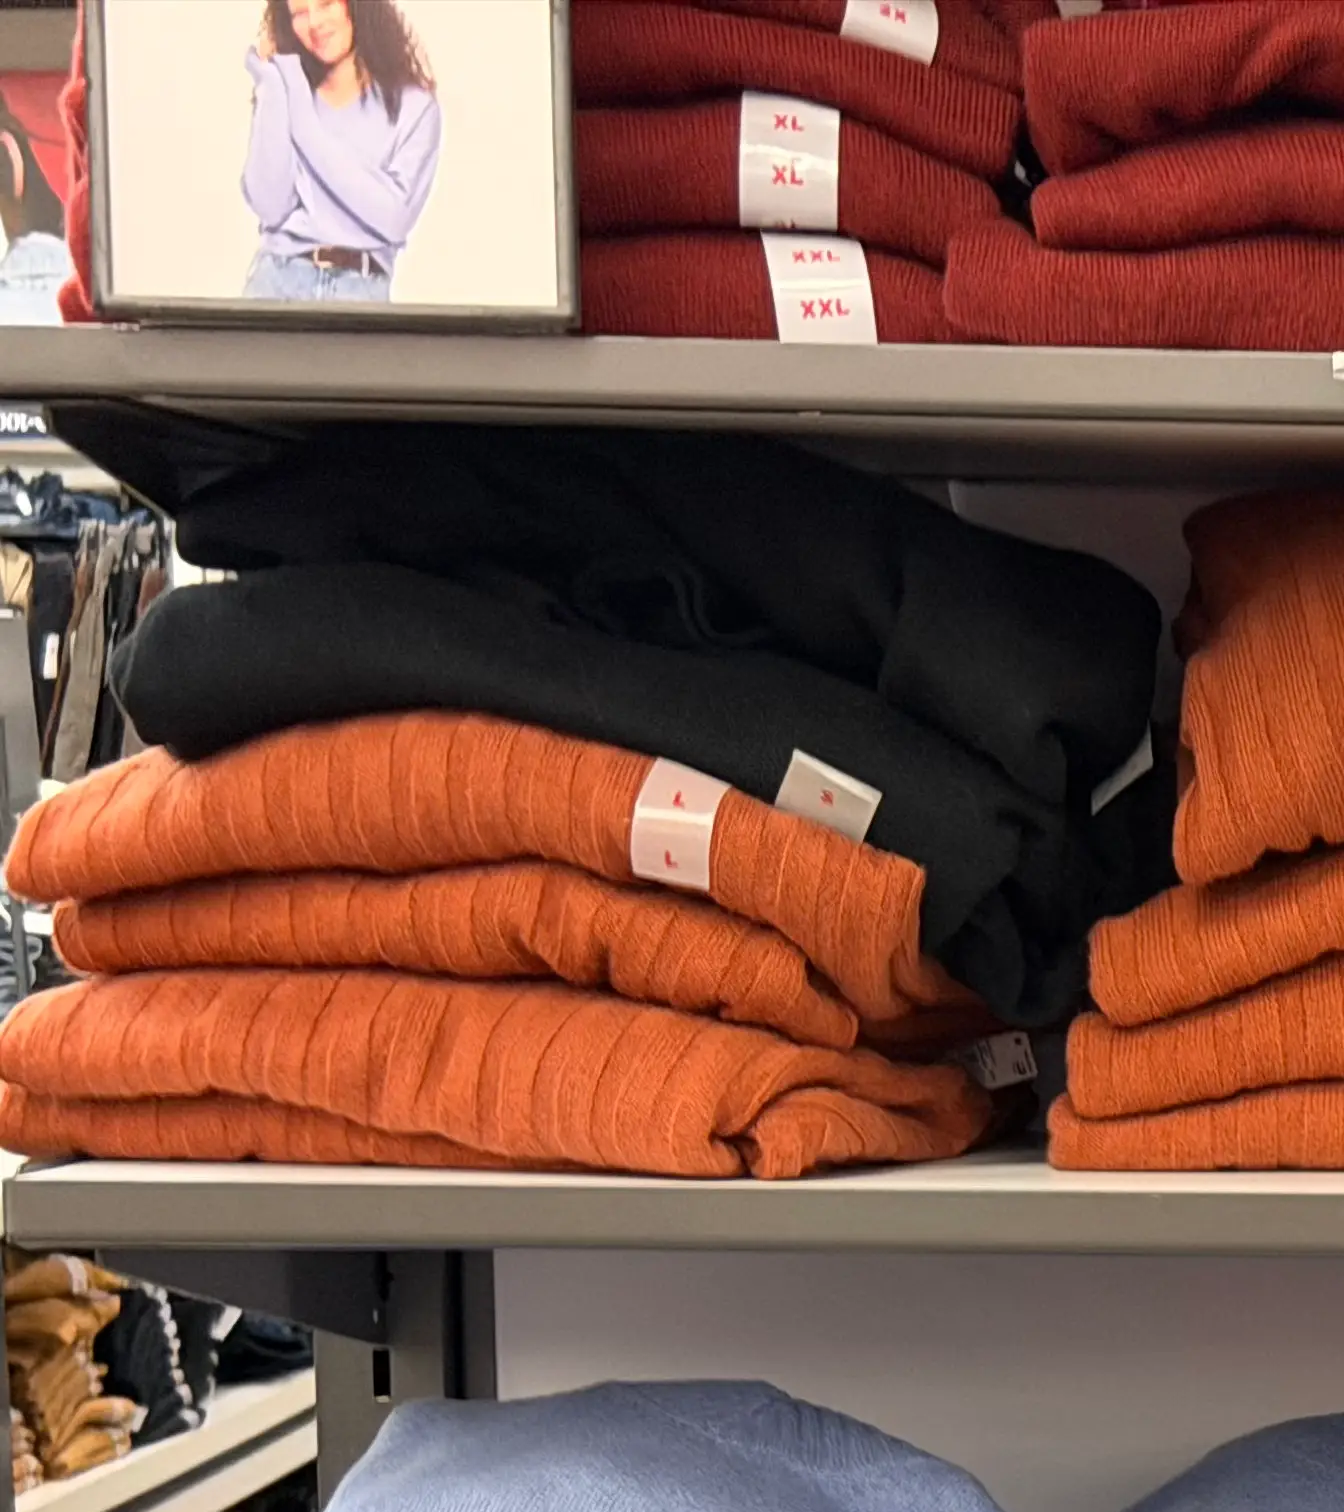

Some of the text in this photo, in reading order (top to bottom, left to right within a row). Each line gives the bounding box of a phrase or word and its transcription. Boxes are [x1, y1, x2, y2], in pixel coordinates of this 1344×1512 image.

[774, 115, 803, 132] XL
[772, 164, 803, 186] XL
[793, 250, 841, 264] XXL
[800, 298, 850, 319] XXL
[673, 790, 686, 810] L
[665, 849, 679, 869] L
